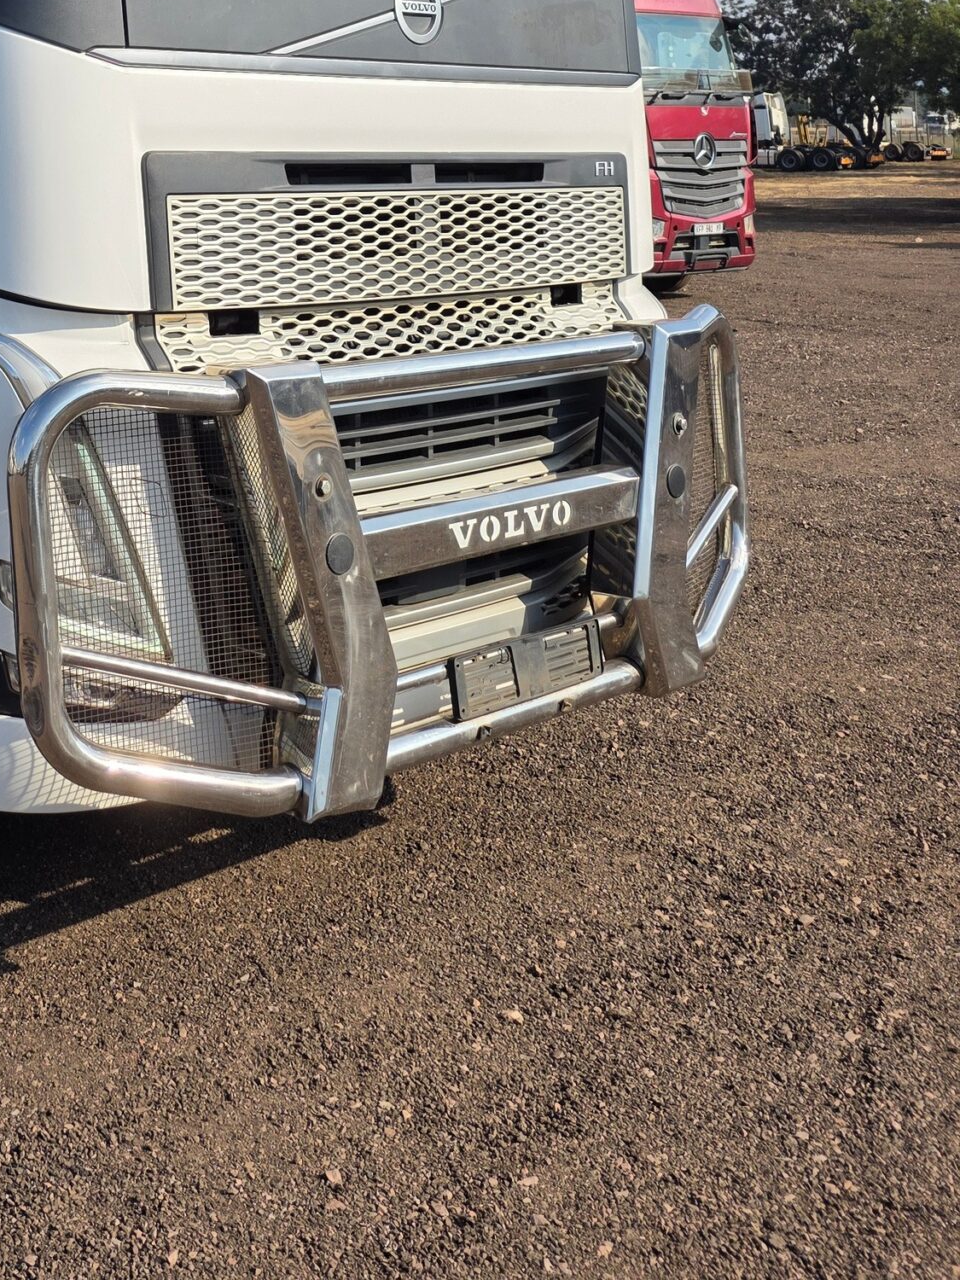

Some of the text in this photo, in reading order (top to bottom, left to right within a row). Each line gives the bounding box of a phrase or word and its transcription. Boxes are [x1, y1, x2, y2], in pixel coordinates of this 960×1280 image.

[402, 2, 436, 12] VOLVO
[595, 161, 614, 176] FH
[449, 500, 571, 549] VOLVO
